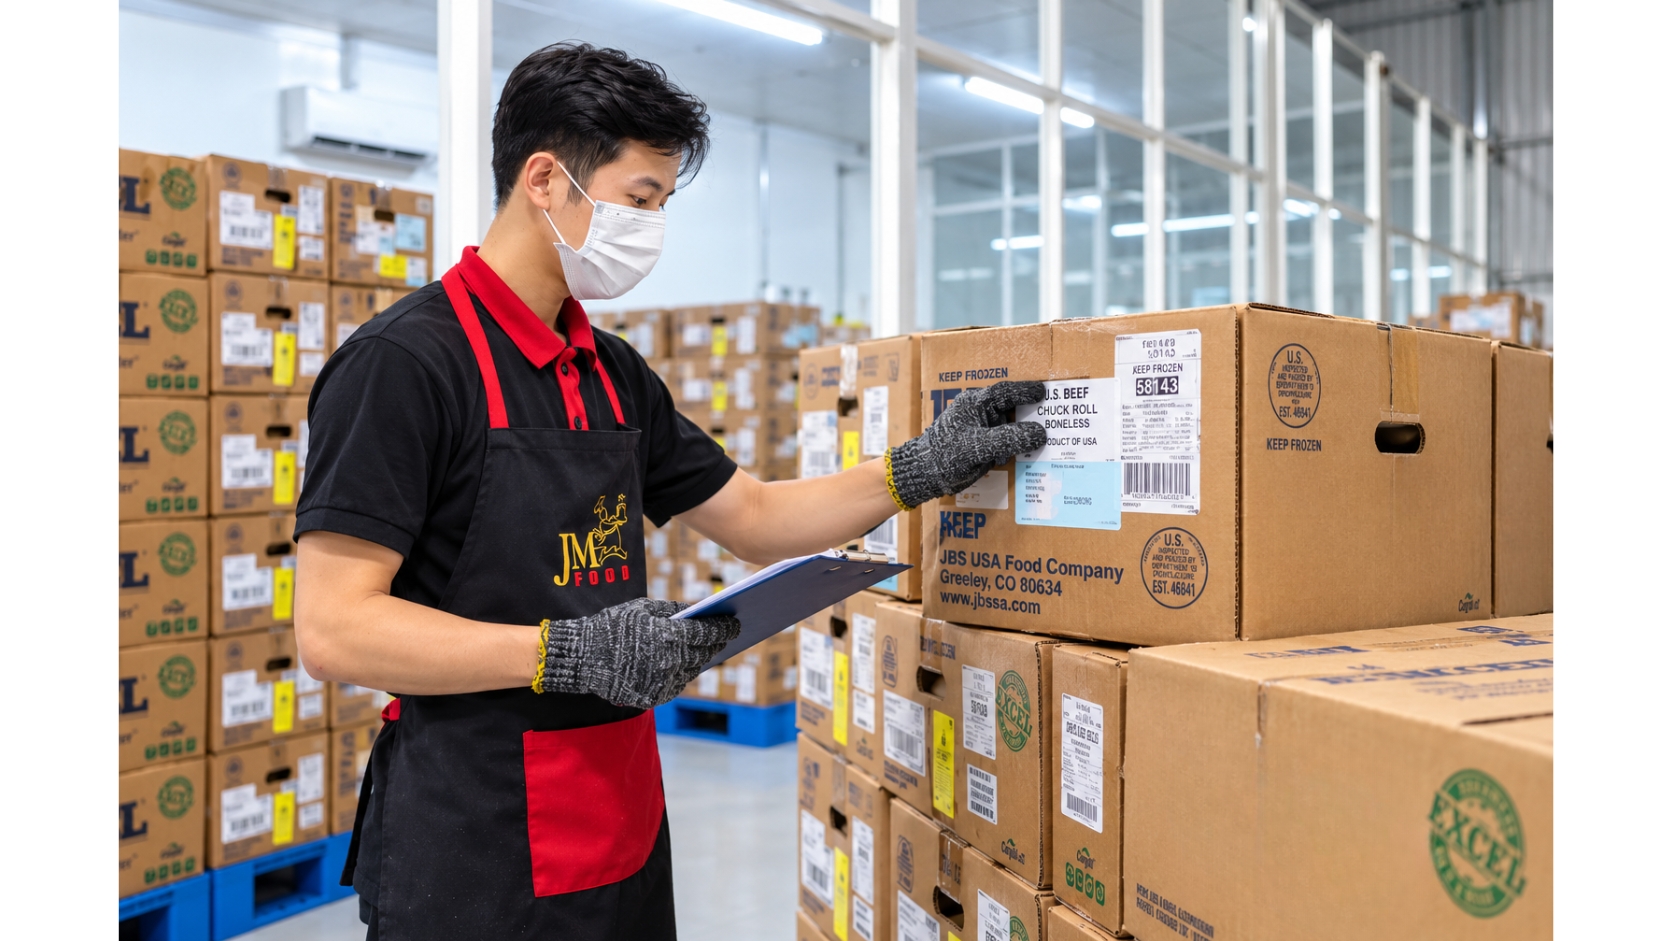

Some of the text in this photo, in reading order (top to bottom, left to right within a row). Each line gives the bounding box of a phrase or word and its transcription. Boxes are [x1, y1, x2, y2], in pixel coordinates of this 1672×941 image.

[1287, 350, 1304, 364] U.S.
[938, 371, 963, 383] KEEP
[1063, 387, 1089, 400] BEEF
[1136, 377, 1179, 396] 58143
[1037, 404, 1098, 416] CHUCK ROLL
[1045, 418, 1090, 429] BONELESS
[1071, 438, 1081, 446] OF
[1082, 437, 1098, 446] USA
[1266, 437, 1322, 453] KEEP FROZEN
[1164, 533, 1184, 547] U.S.
[553, 531, 601, 586] JM
[939, 549, 1124, 585] JBS USA Food Company
[573, 565, 630, 587] FOOD
[939, 569, 1062, 597] Greeley, CO 80634
[1152, 579, 1170, 594] EST.
[940, 591, 1041, 614] www.jbssa.com
[995, 684, 1033, 738] EXCEL
[1428, 790, 1527, 897] EXCEL
